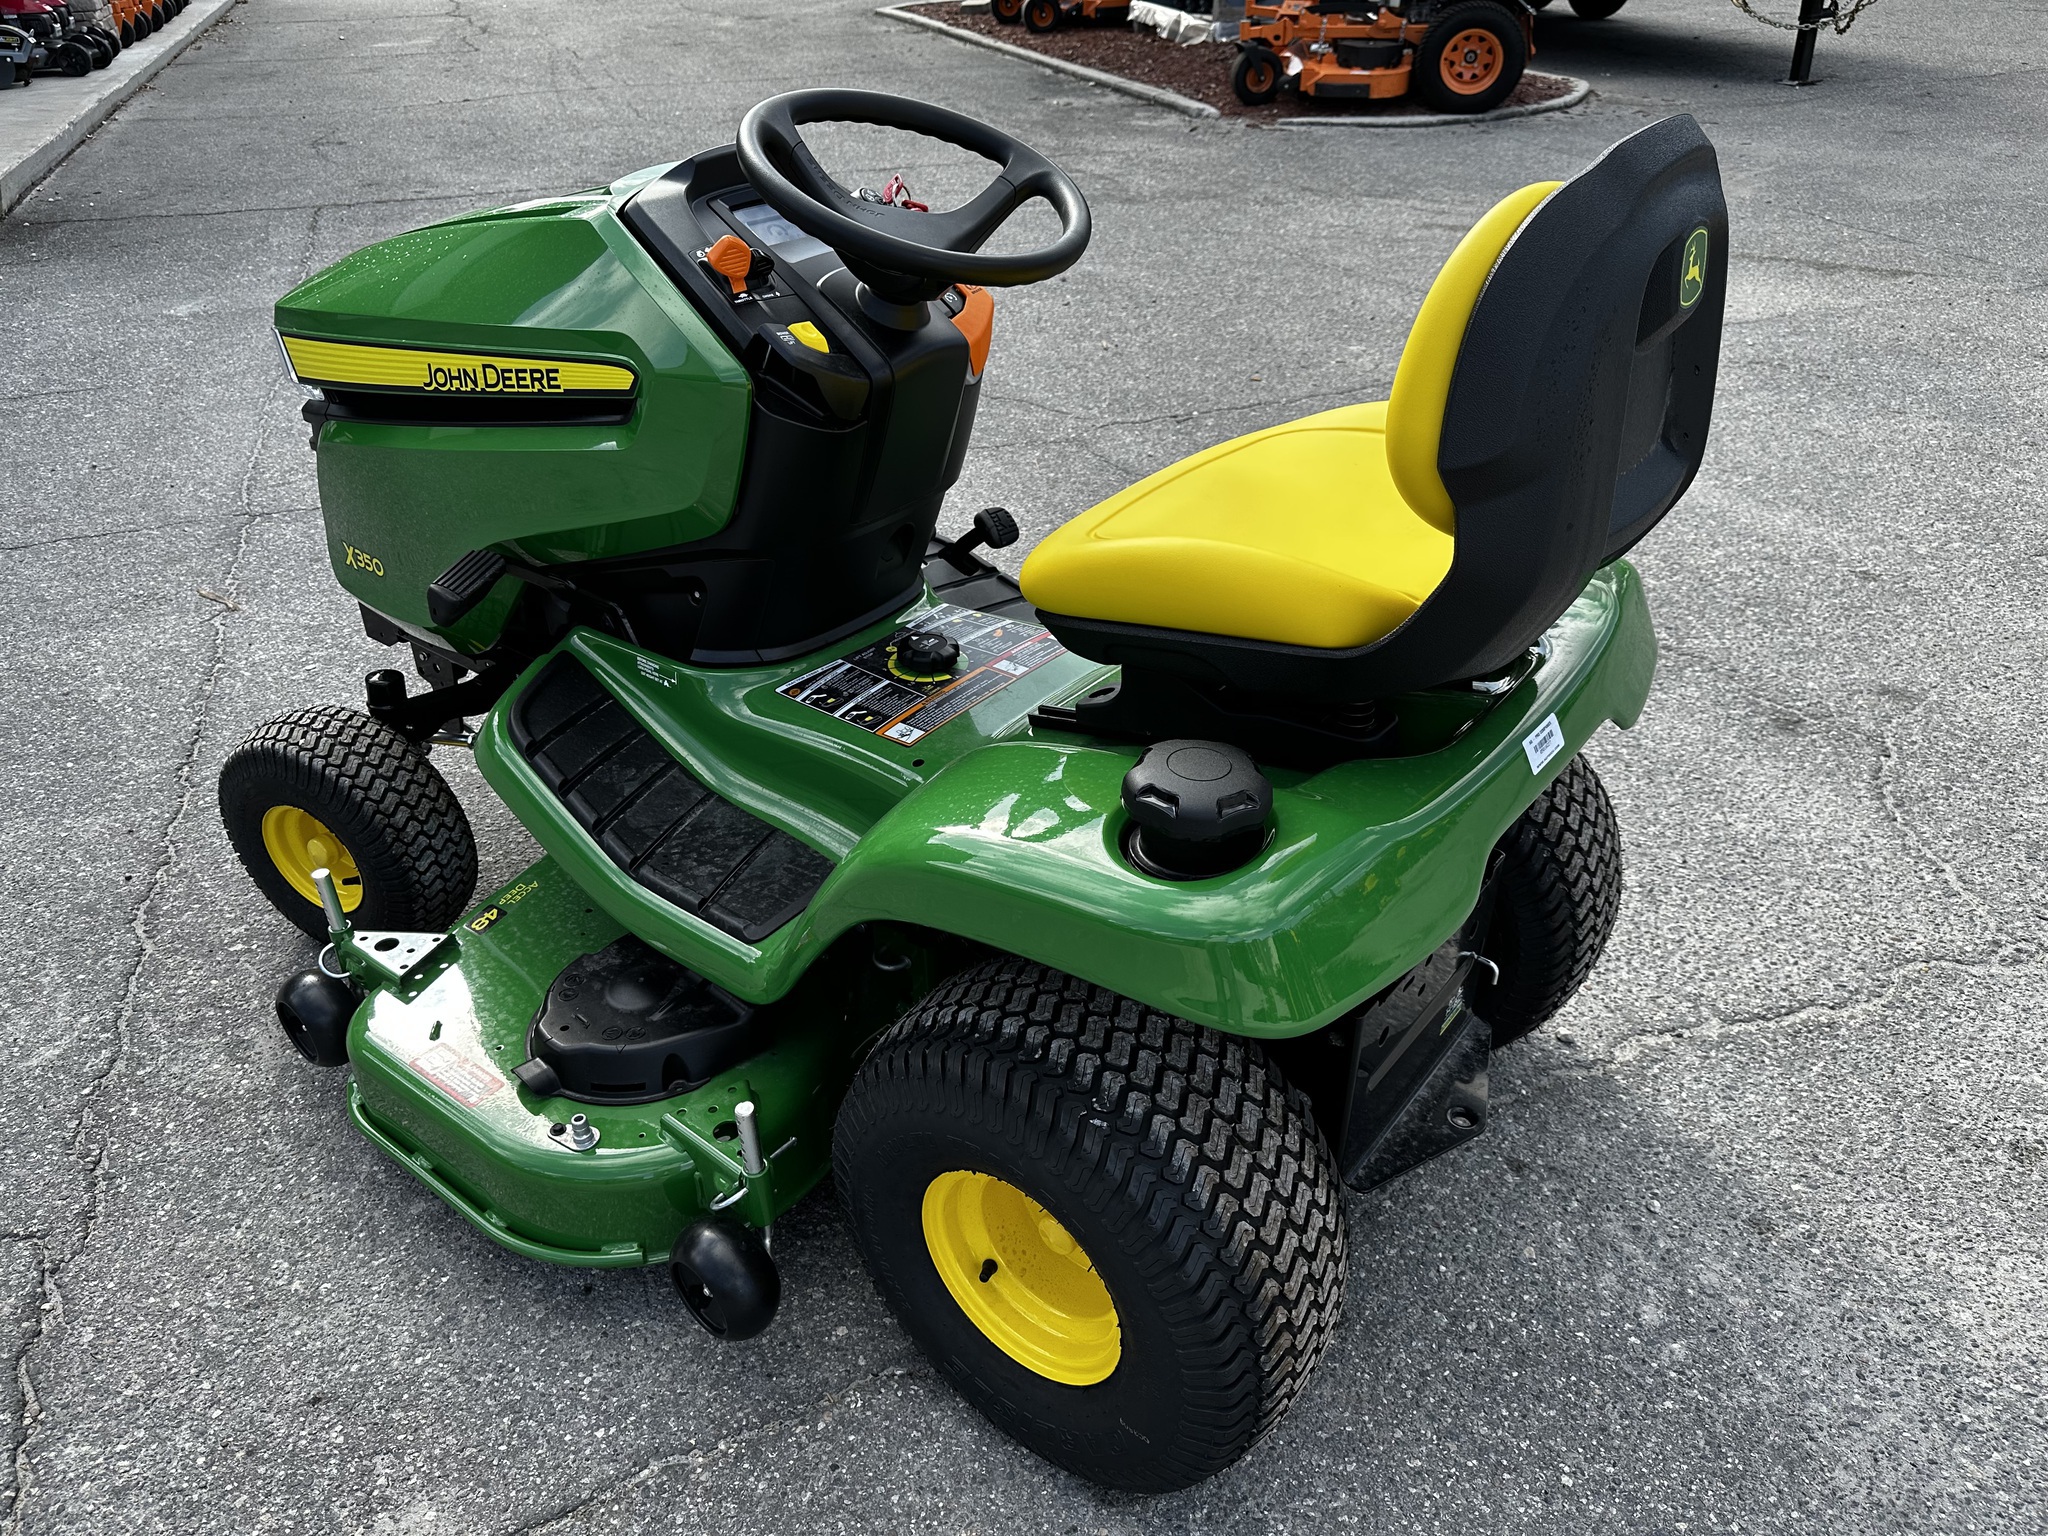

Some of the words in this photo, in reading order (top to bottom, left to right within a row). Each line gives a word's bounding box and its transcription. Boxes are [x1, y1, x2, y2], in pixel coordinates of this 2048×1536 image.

[423, 363, 481, 391] JOHN
[481, 363, 564, 392] DEERE
[342, 541, 384, 577] X350
[499, 883, 526, 905] DEEP
[507, 881, 538, 904] ACCEL
[471, 908, 498, 931] 48
